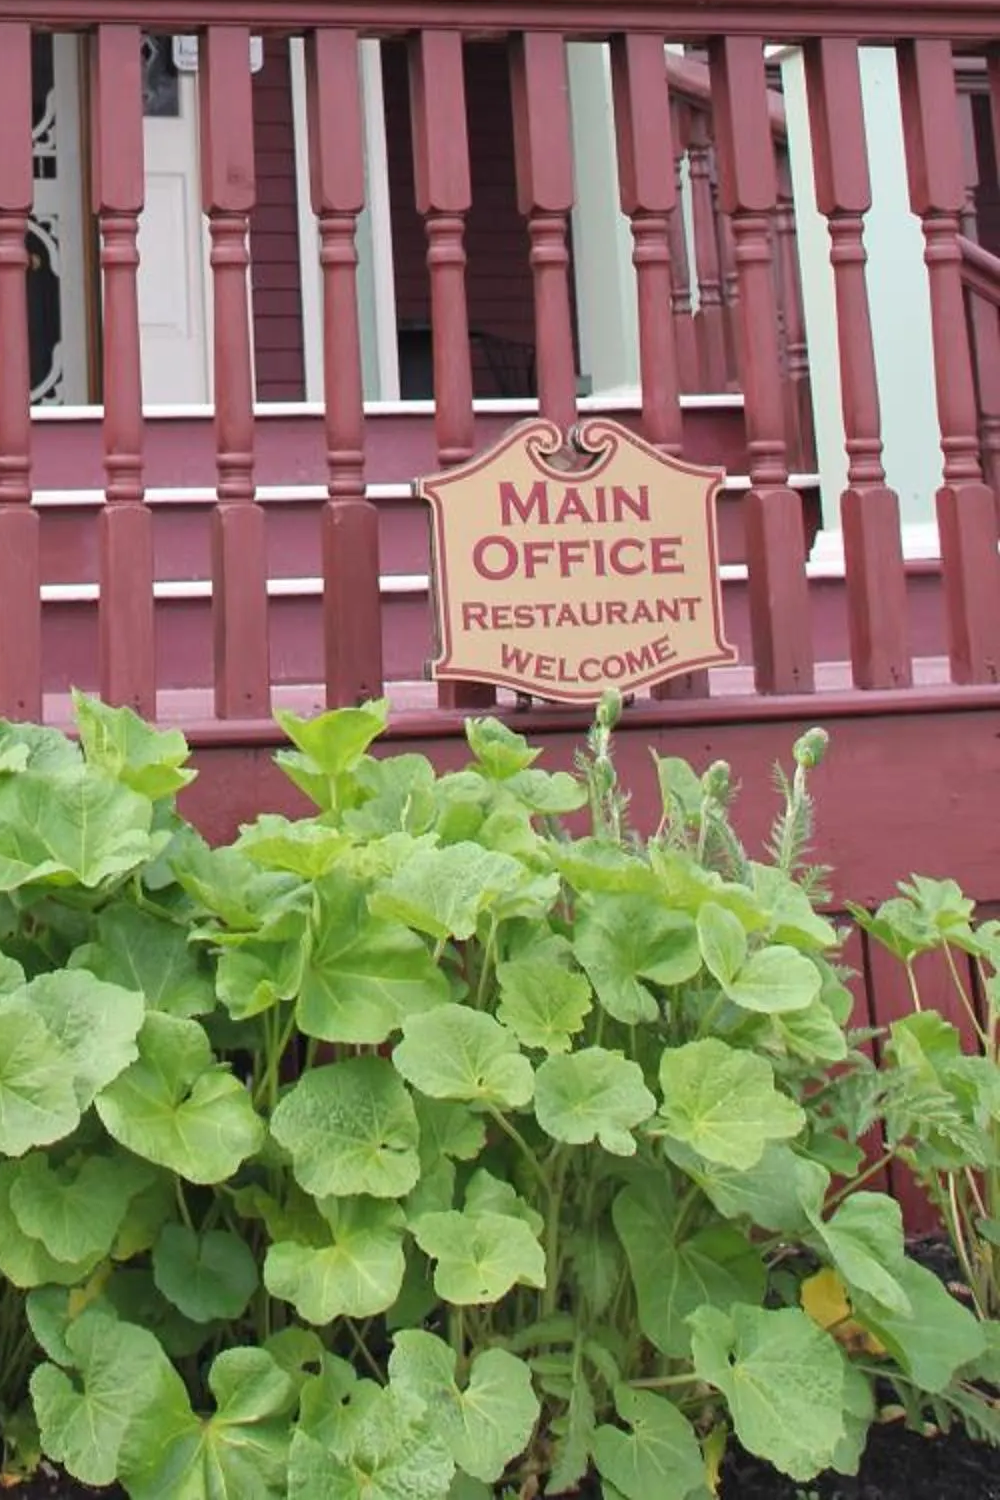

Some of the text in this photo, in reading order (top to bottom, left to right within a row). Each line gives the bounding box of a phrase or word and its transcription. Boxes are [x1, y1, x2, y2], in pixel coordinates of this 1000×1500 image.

[499, 480, 650, 527] MAIN
[472, 535, 685, 581] OFFICE
[461, 596, 702, 631] RESTAURANT
[500, 634, 678, 684] WELCOME
